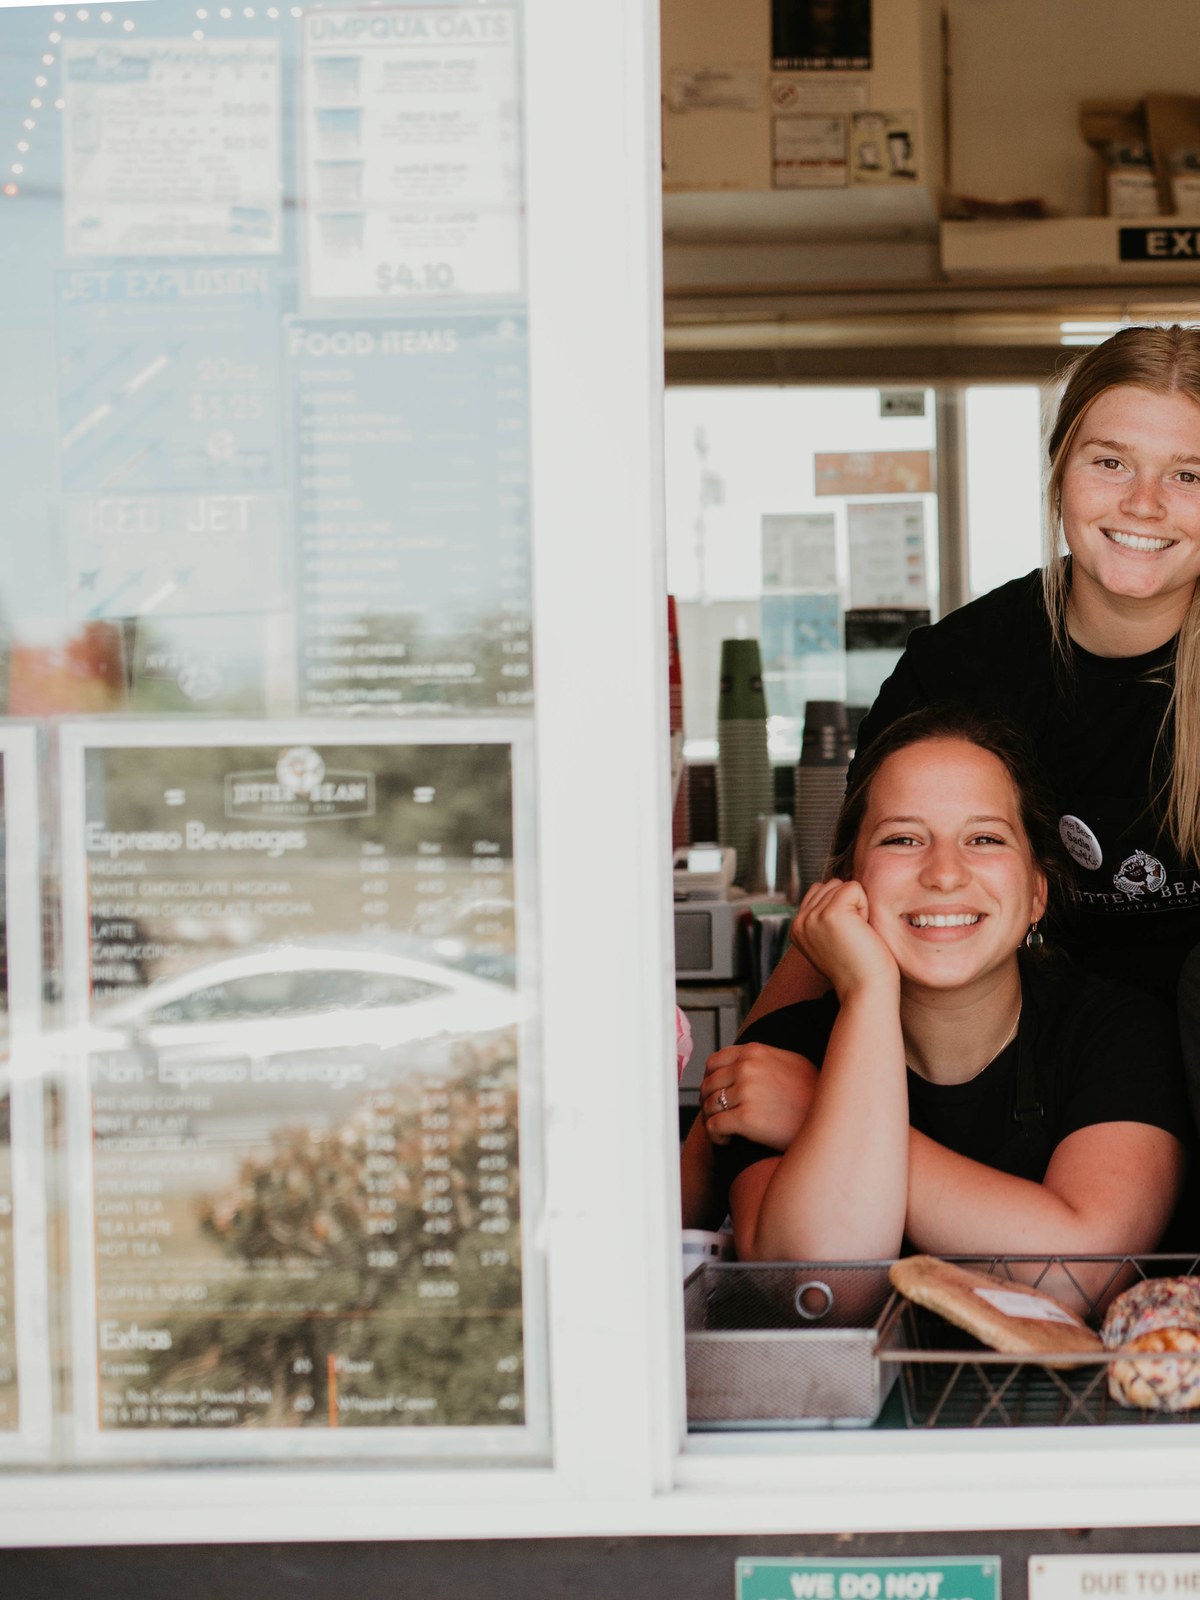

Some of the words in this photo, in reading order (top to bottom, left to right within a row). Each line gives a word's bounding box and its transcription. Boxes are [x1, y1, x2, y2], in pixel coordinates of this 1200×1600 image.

[311, 14, 429, 39] UMPQUA
[435, 13, 507, 37] OATS
[61, 271, 113, 300] JET
[125, 268, 269, 297] EXPLOSION
[288, 328, 376, 356] FOOD
[381, 328, 459, 355] ITEMS
[187, 496, 257, 532] JET
[87, 821, 183, 858] Espresso
[185, 820, 308, 858] Beverages
[1066, 831, 1090, 851] Sadie
[91, 923, 134, 939] LATTE
[92, 1055, 143, 1083] Non
[158, 1056, 247, 1090] Espresso
[252, 1057, 366, 1089] Beverages
[99, 1321, 172, 1350] Extras
[790, 1573, 835, 1599] WE
[840, 1573, 881, 1599] DO
[886, 1572, 944, 1598] NOT
[1080, 1571, 1127, 1595] DUE
[1134, 1570, 1165, 1594] TO
